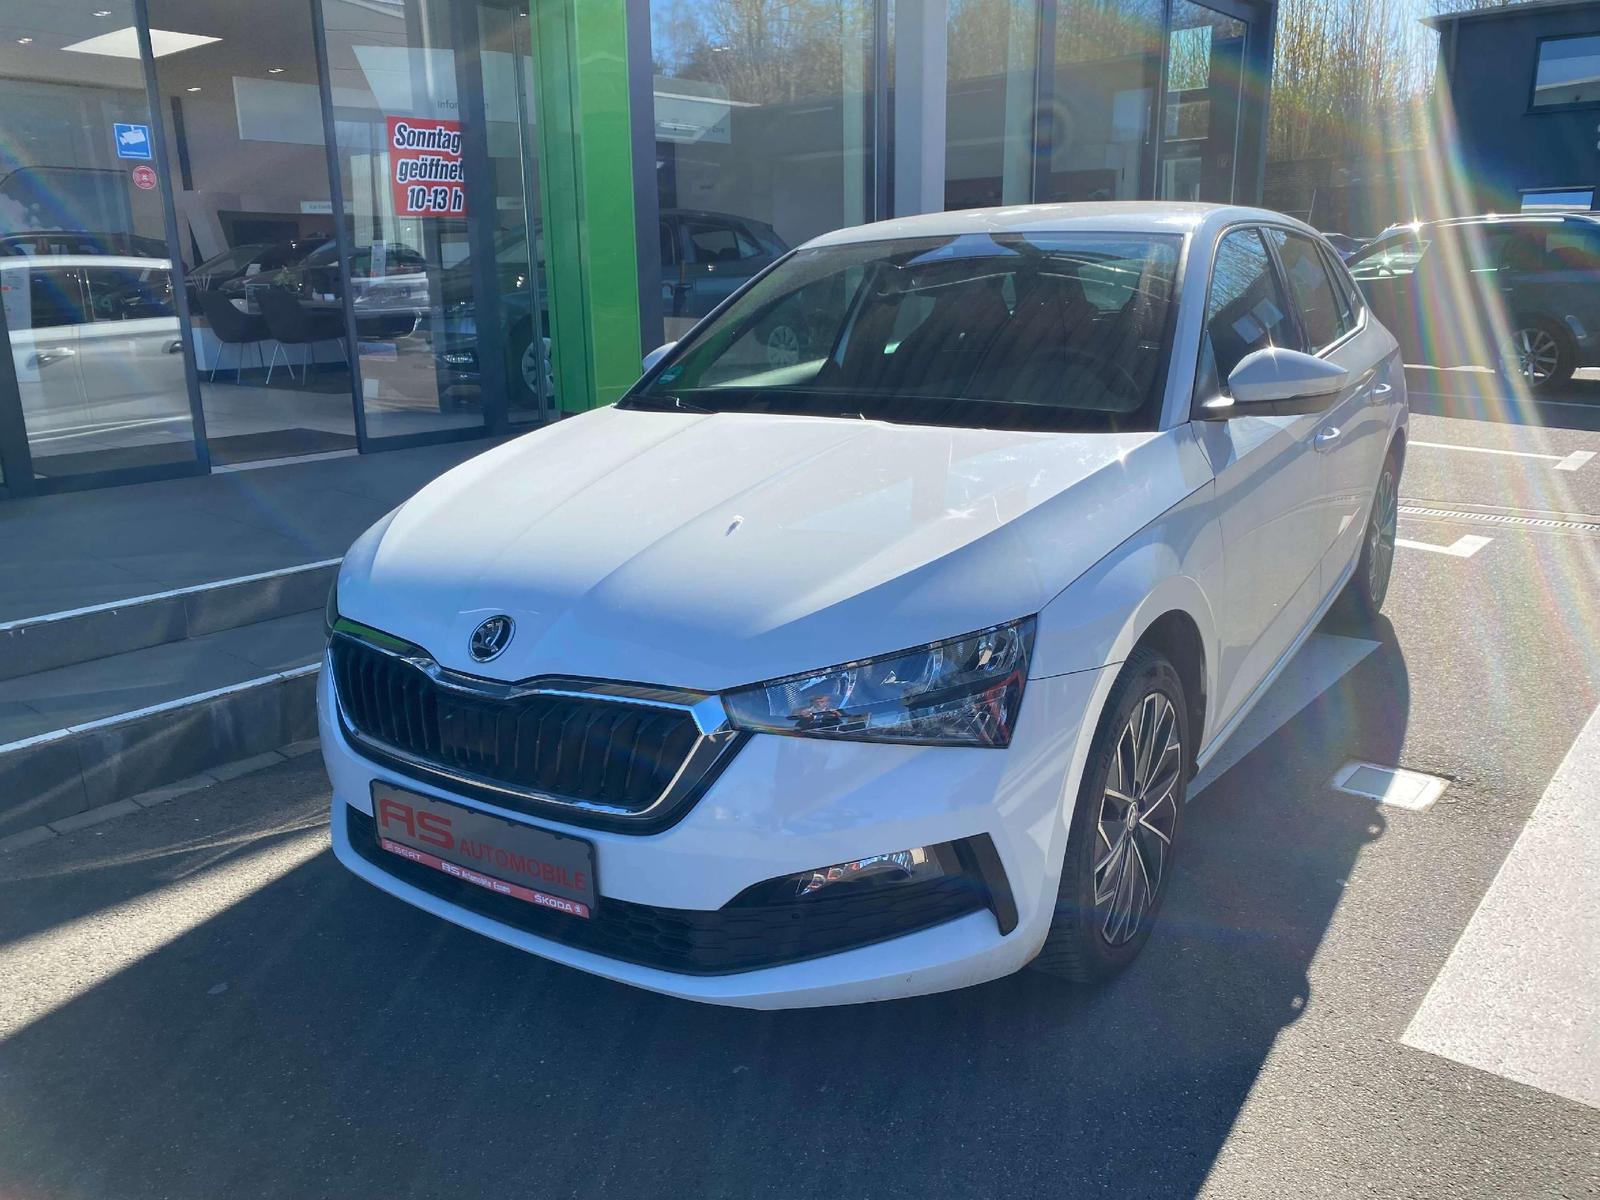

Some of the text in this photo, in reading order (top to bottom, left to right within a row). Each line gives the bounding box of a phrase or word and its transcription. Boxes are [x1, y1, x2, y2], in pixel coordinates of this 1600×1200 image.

[394, 123, 462, 154] Sonntag
[397, 156, 464, 183] geöffnet
[407, 186, 464, 211] 10-13 h
[379, 798, 455, 850] AS
[460, 840, 586, 891] AUTOMOBILE
[393, 846, 421, 861] SEAT
